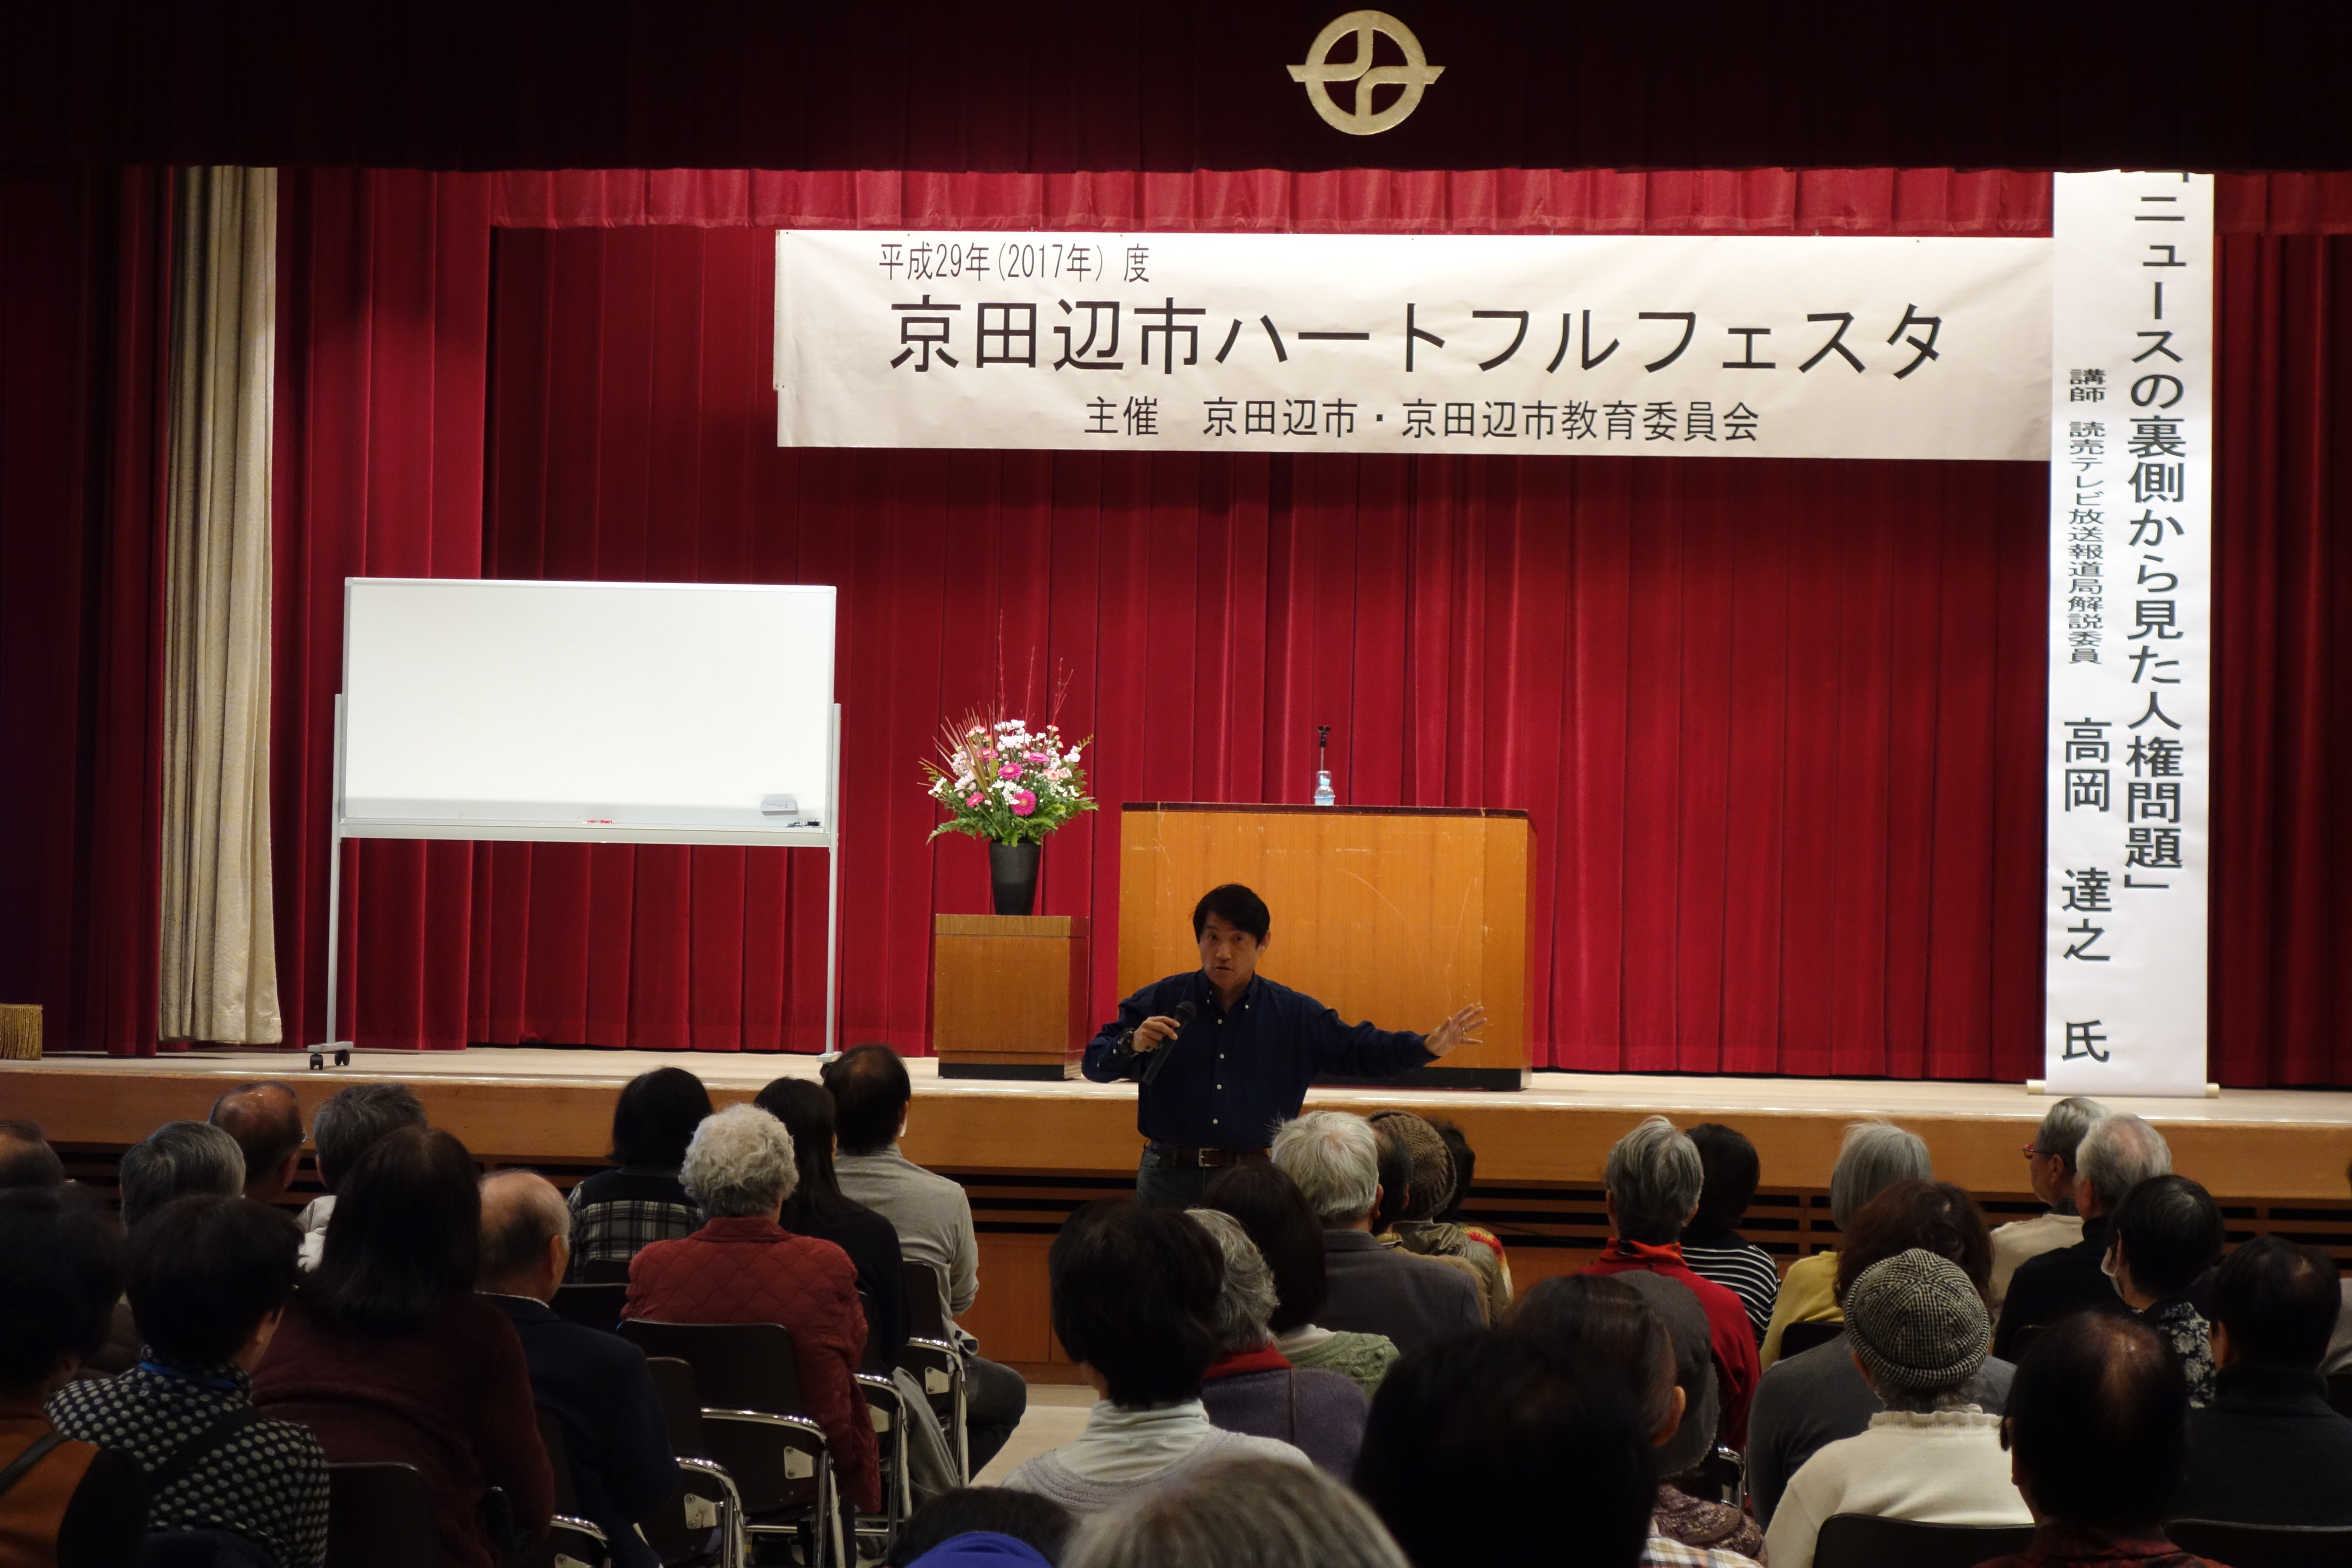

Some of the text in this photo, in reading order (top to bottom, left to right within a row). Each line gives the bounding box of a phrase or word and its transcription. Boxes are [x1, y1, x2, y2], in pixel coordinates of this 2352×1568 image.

[889, 294, 1942, 380] 京田辺市ハートフルフェスタ
[1084, 395, 1759, 442] 主催 京田辺市・京田辺市教育委員会
[2061, 368, 2112, 1063] 講師 読売テレビ放送報道局解説委員 高岡 達之 氏
